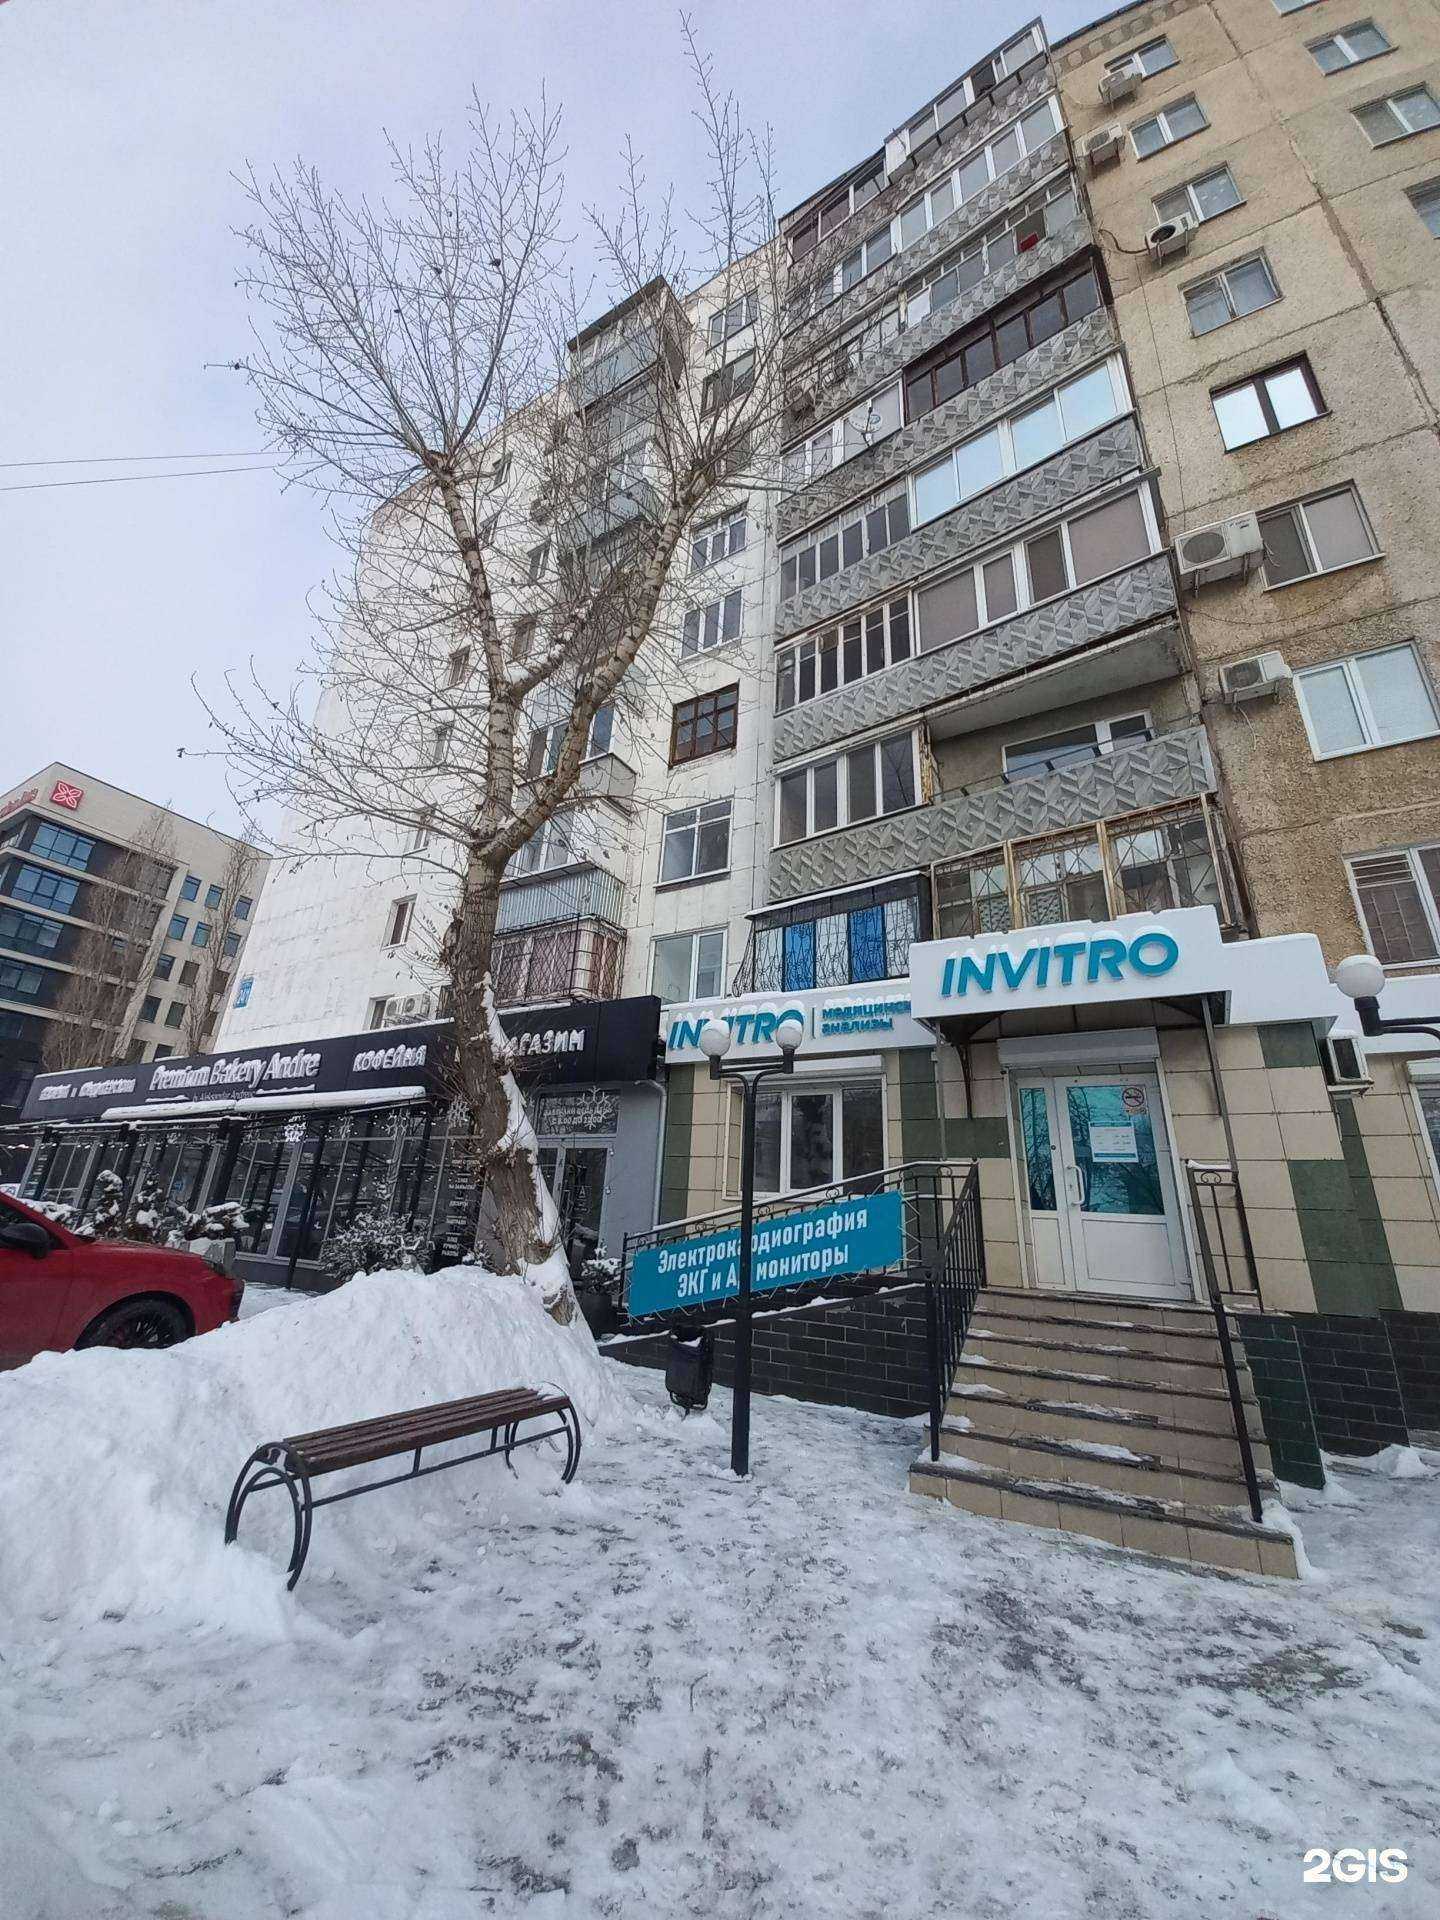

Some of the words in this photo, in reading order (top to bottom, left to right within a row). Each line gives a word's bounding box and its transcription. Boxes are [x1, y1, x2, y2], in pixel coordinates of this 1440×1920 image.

[941, 932, 1179, 997] INVITRO
[505, 1029, 585, 1057] АГАЗИН
[149, 1065, 211, 1091] Premium
[209, 1057, 266, 1089] Bakery
[264, 1048, 322, 1081] Andre
[677, 1268, 708, 1298] ЭКГ
[712, 1272, 721, 1291] и
[726, 1262, 741, 1290] А
[756, 1246, 849, 1282] мониторы
